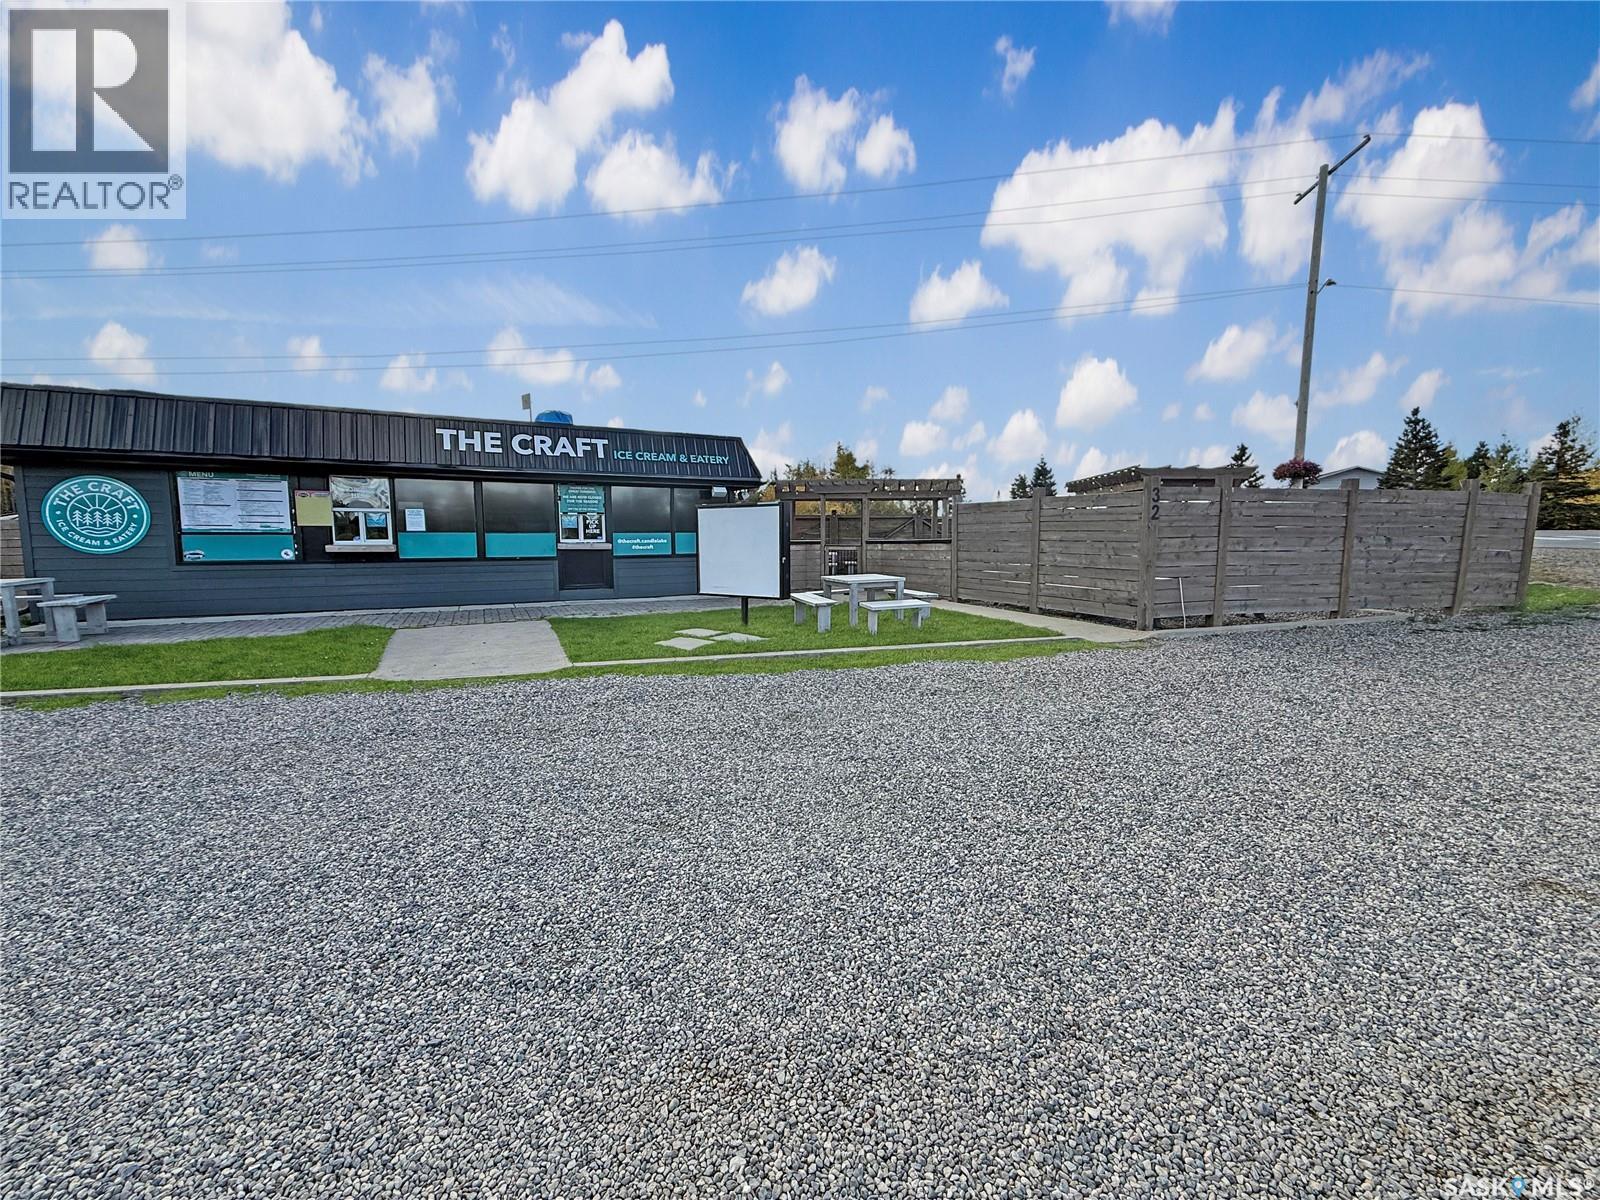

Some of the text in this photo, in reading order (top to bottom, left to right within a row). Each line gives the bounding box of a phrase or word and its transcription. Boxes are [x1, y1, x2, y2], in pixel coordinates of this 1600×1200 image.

[435, 428, 609, 459] THE CRAFT
[613, 450, 730, 465] ICE CREAM & EATERY
[53, 482, 140, 510] THE CRAFT
[56, 519, 70, 533] ICE
[67, 531, 101, 546] CREAM
[112, 522, 138, 545] EATERY
